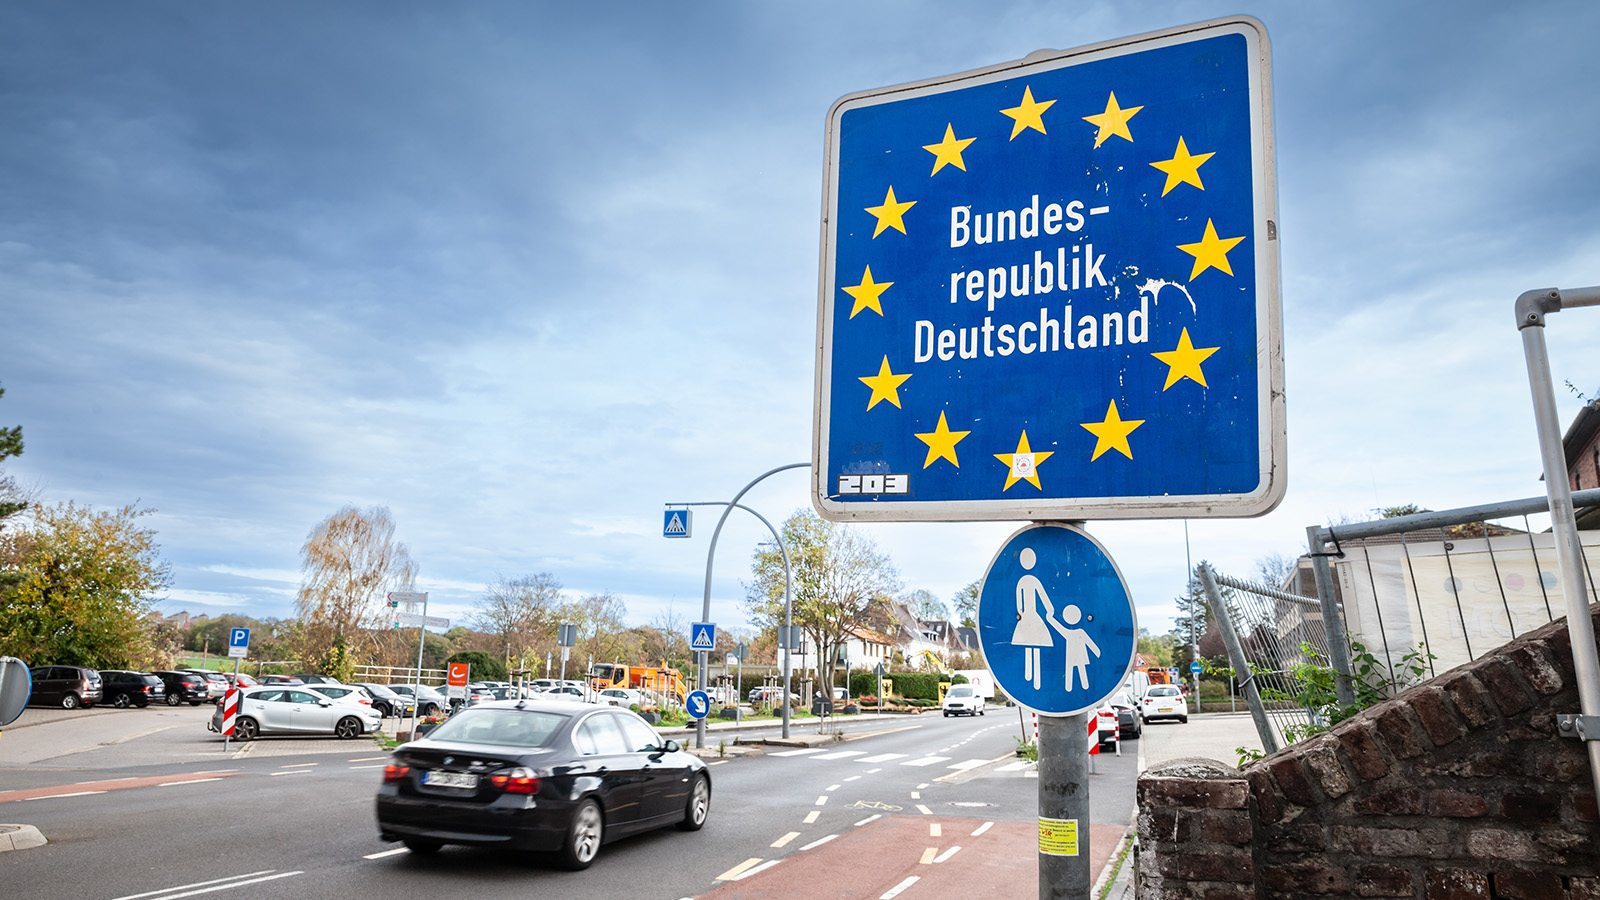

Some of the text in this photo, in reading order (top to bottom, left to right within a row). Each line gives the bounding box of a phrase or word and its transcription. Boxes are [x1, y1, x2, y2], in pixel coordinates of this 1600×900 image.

[950, 194, 1109, 248] Bundes-
[950, 243, 1107, 312] republik
[914, 296, 1149, 363] Deutschland
[234, 630, 246, 645] P
